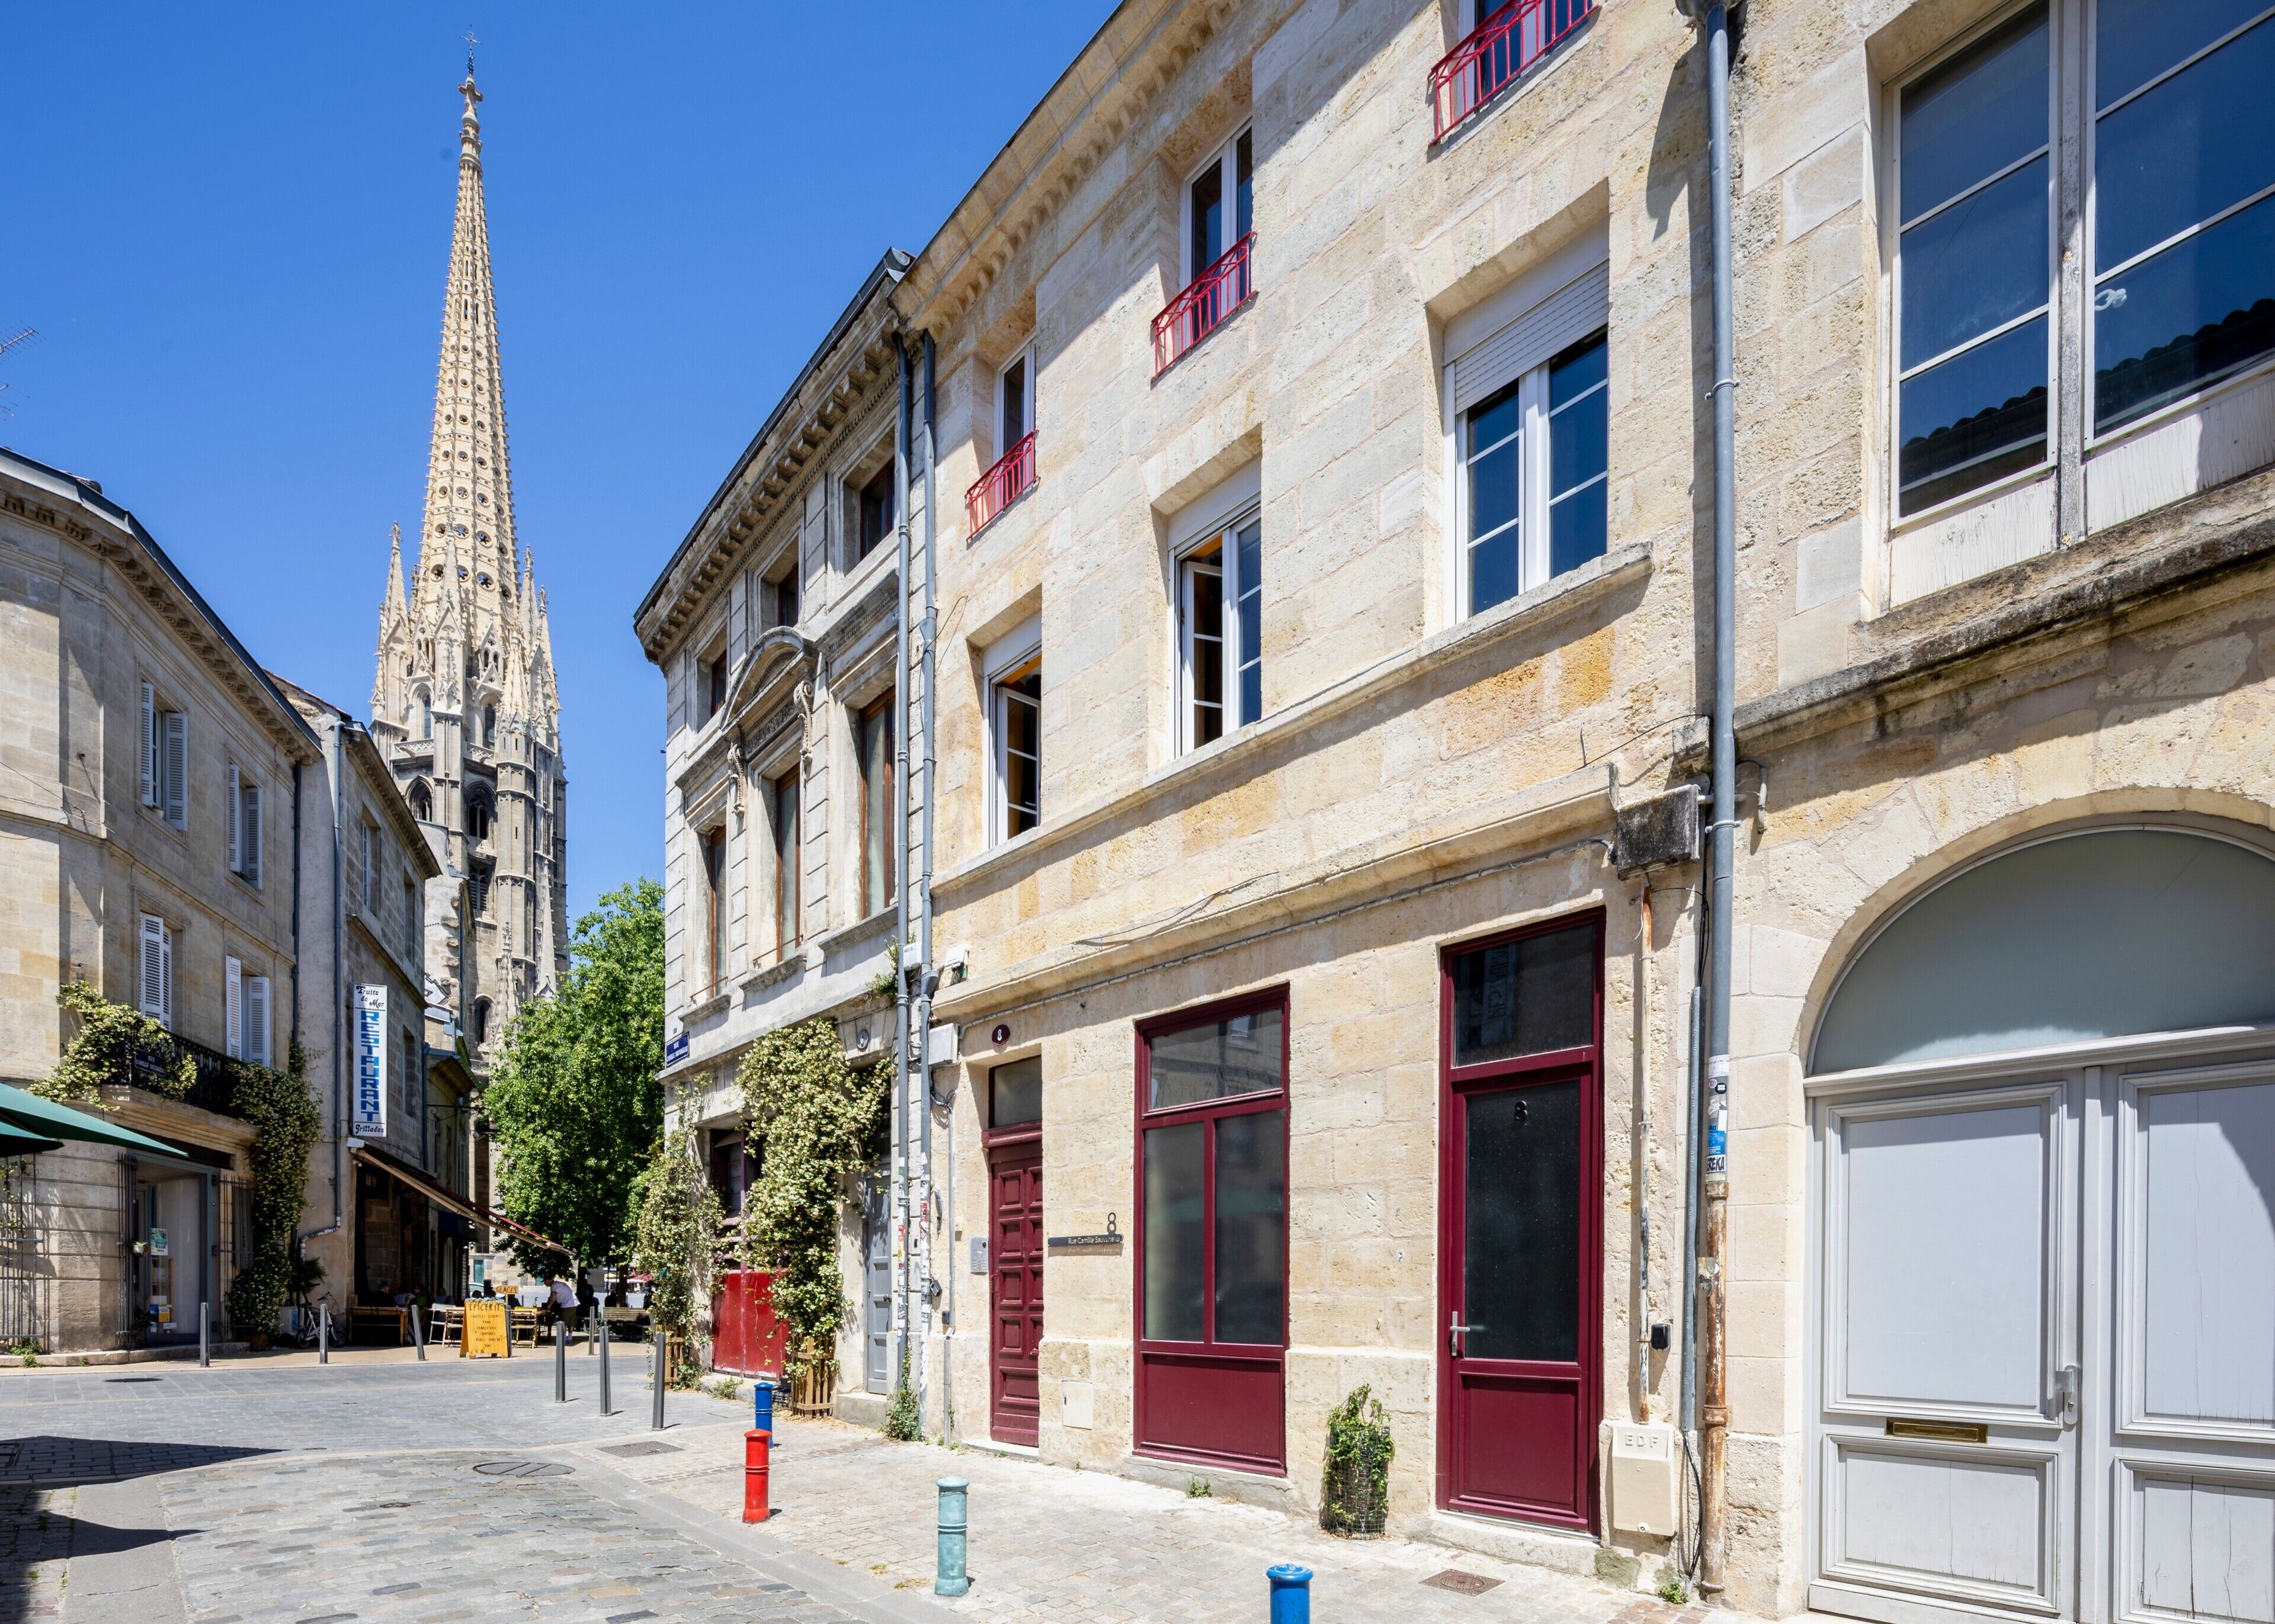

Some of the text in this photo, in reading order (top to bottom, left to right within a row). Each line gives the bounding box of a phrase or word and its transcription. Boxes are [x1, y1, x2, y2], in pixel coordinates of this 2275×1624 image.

[355, 986, 379, 995] Fruits
[369, 999, 384, 1009] Mer
[997, 1029, 1002, 1041] 8
[361, 1010, 379, 1121] RESTAURANT
[355, 1124, 384, 1134] Grillades
[1107, 1212, 1117, 1234] 8
[1625, 1434, 1658, 1448] EDF
